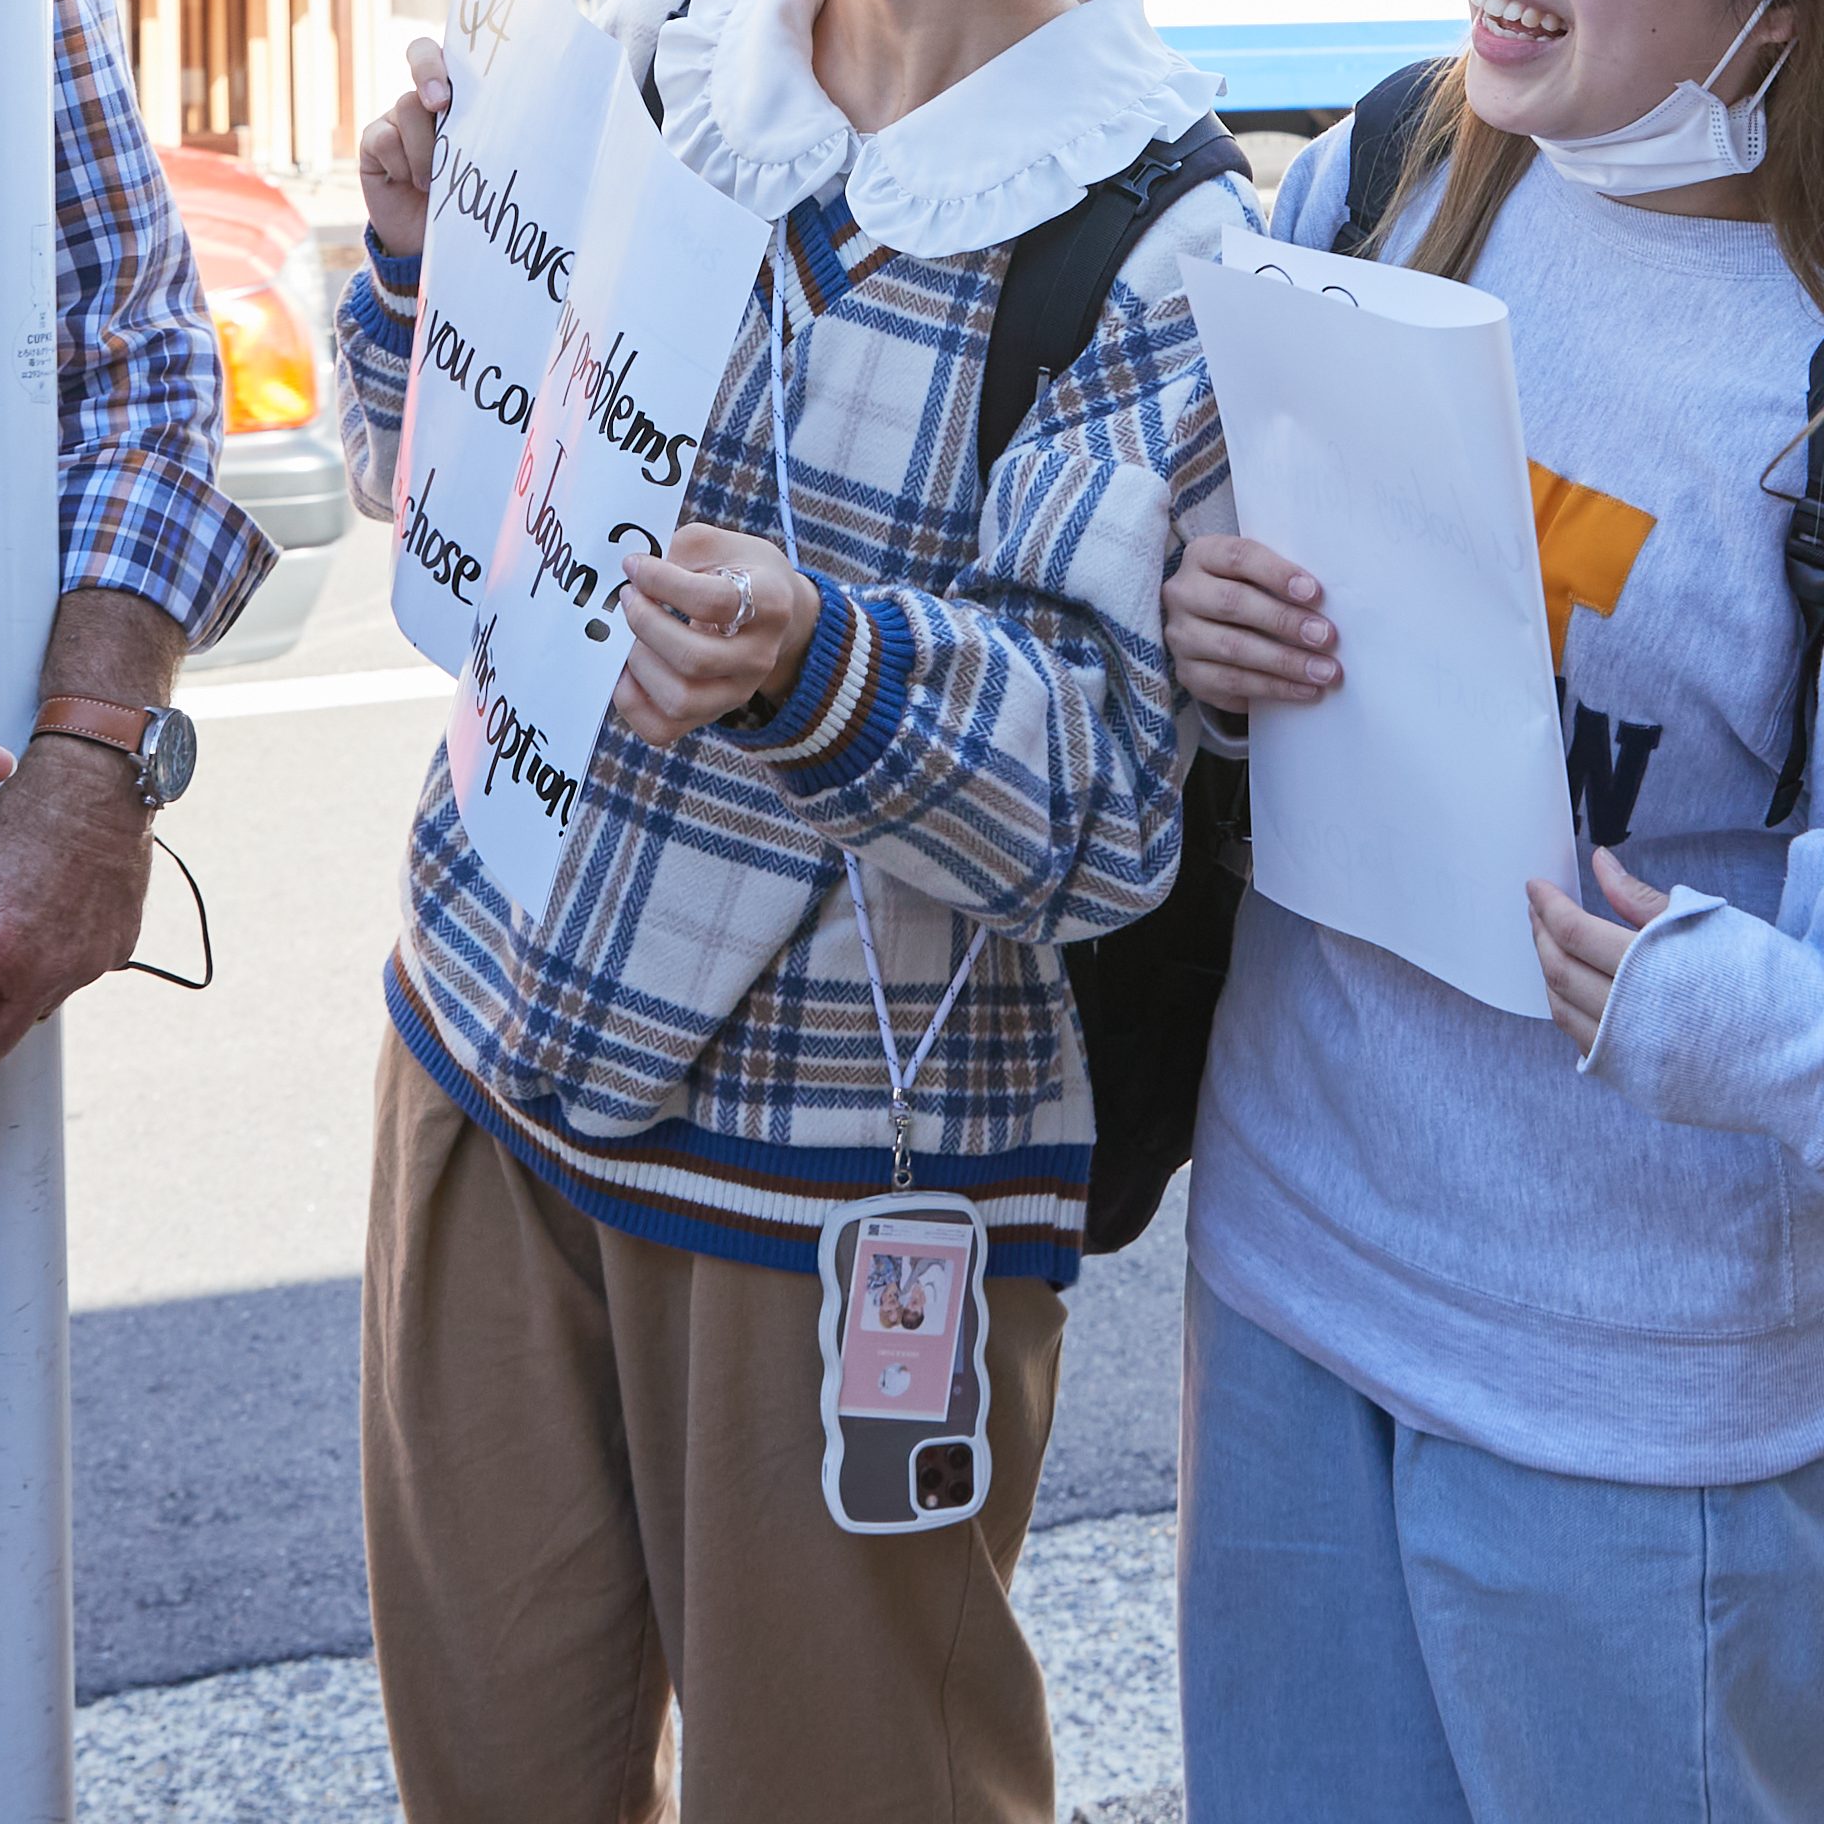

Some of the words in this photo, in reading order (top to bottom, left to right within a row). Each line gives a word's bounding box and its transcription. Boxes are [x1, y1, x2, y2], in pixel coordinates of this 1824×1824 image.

[417, 309, 476, 392] you
[433, 147, 497, 234] you
[489, 169, 576, 304] have
[562, 331, 698, 487] problems
[400, 467, 482, 607] chose
